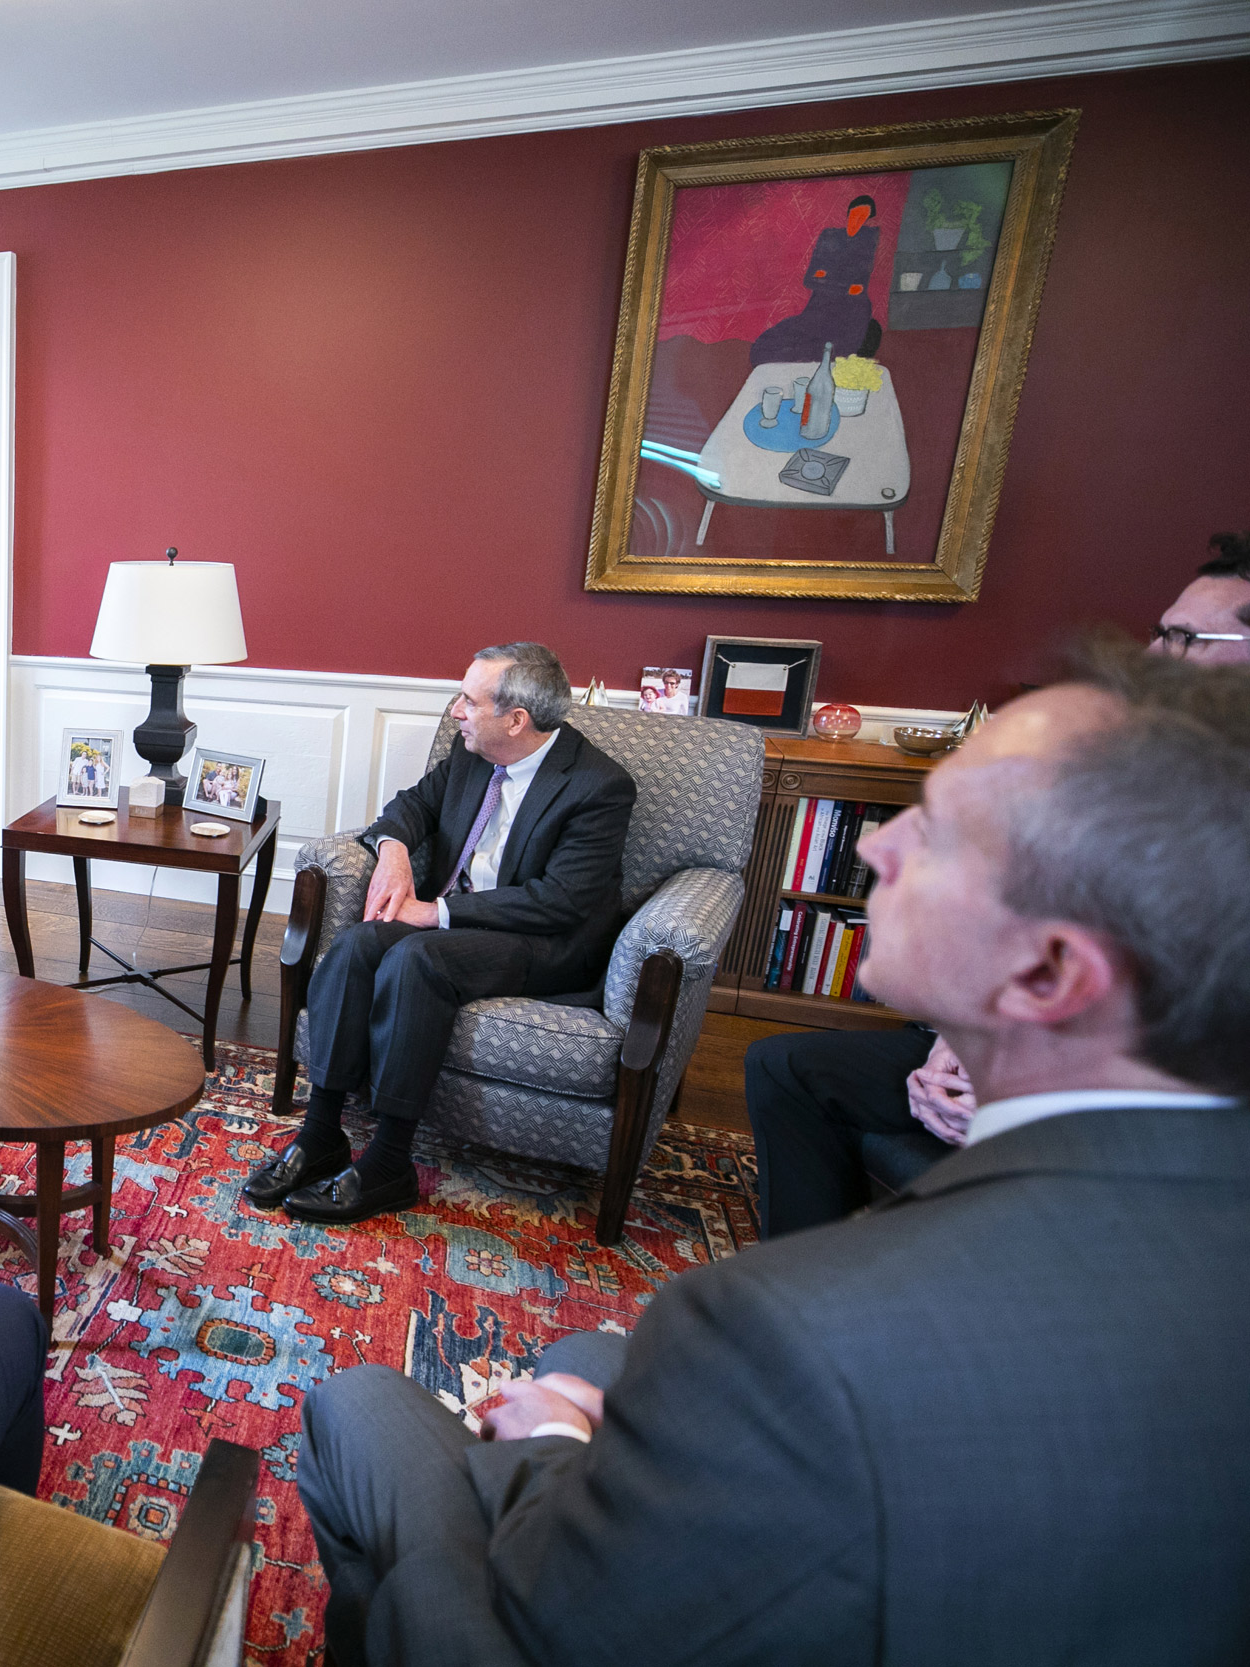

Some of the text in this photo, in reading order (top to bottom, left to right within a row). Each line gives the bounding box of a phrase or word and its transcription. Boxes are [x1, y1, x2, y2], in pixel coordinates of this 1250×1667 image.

[829, 809, 842, 837] Monviso
[787, 911, 803, 971] Celebrating Entrepreneurship
